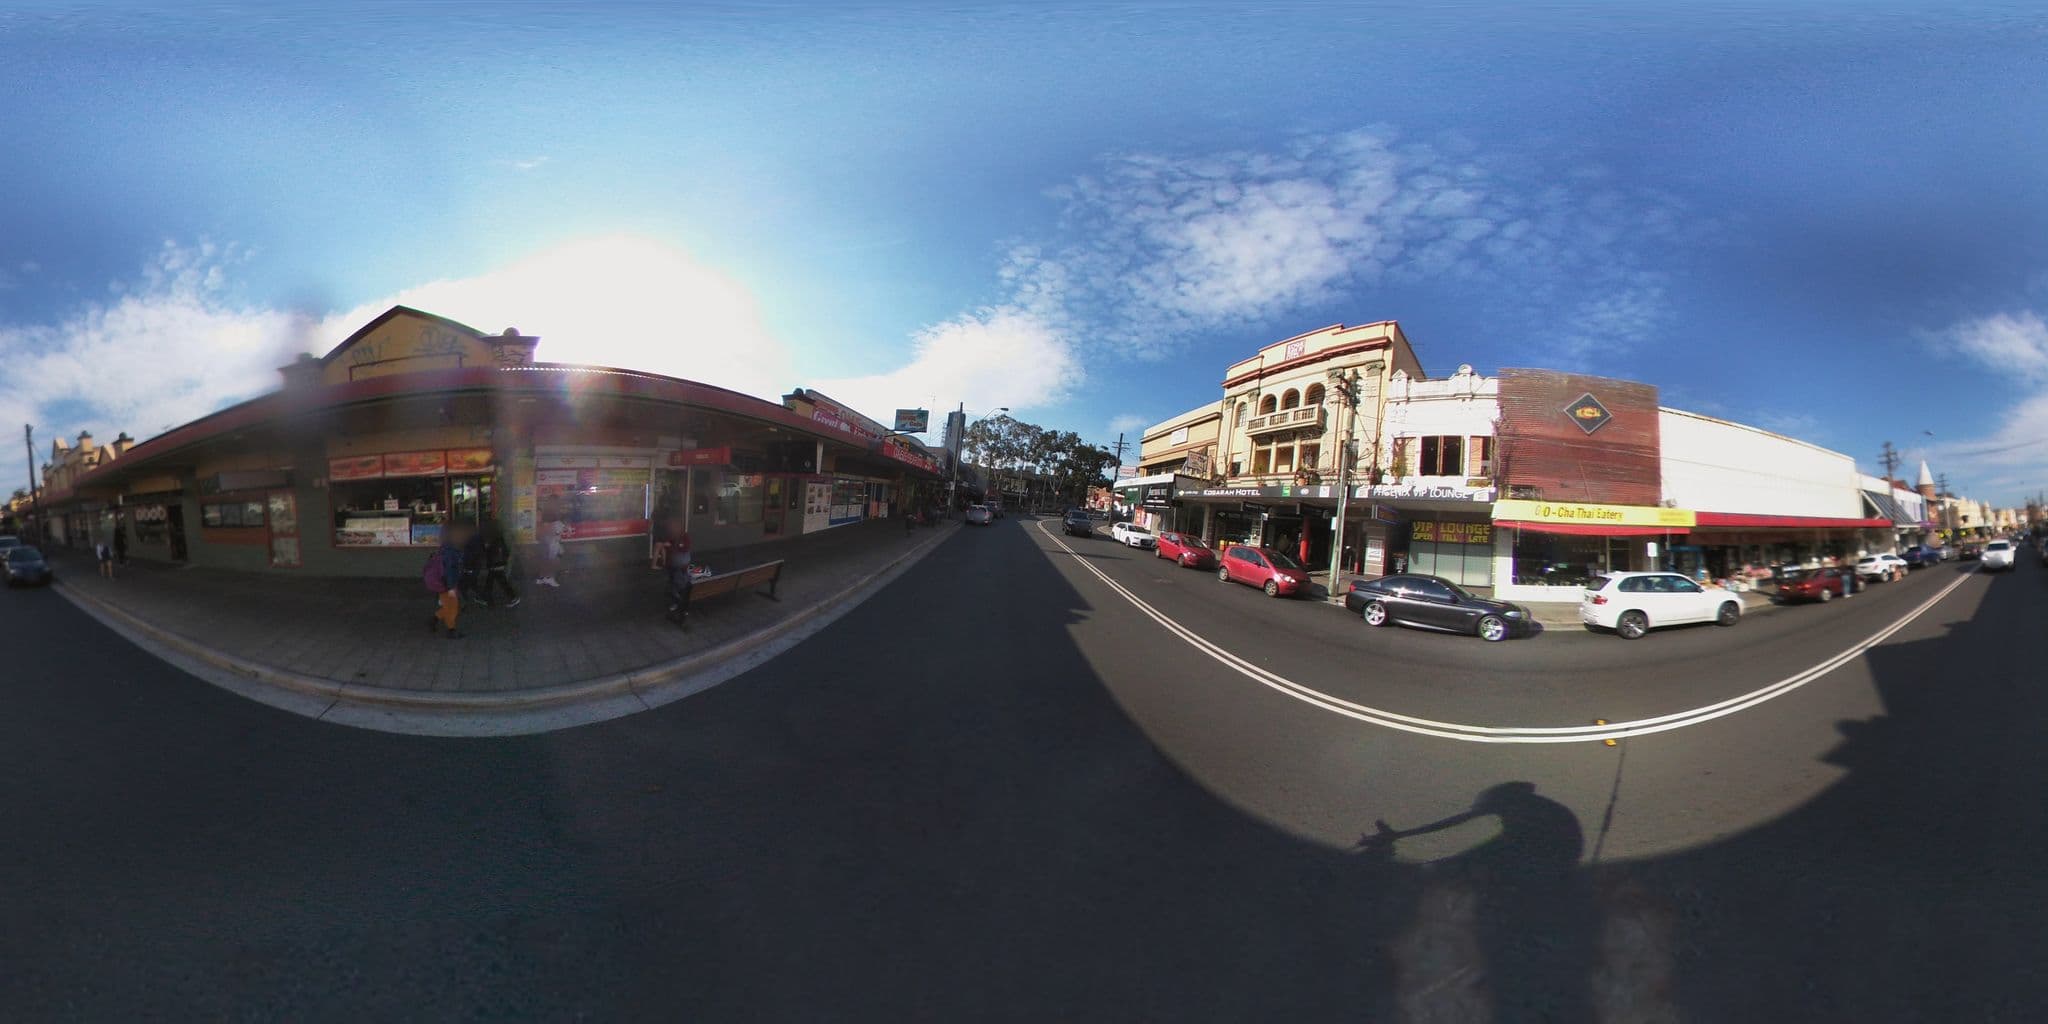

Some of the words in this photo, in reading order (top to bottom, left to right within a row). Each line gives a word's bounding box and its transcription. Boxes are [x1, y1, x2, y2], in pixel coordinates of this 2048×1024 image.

[1413, 488, 1427, 497] VIP
[1430, 488, 1469, 499] LOUNGE
[1577, 507, 1594, 519] Thai
[1412, 521, 1433, 532] VIP
[1440, 522, 1490, 534] LOUNGE
